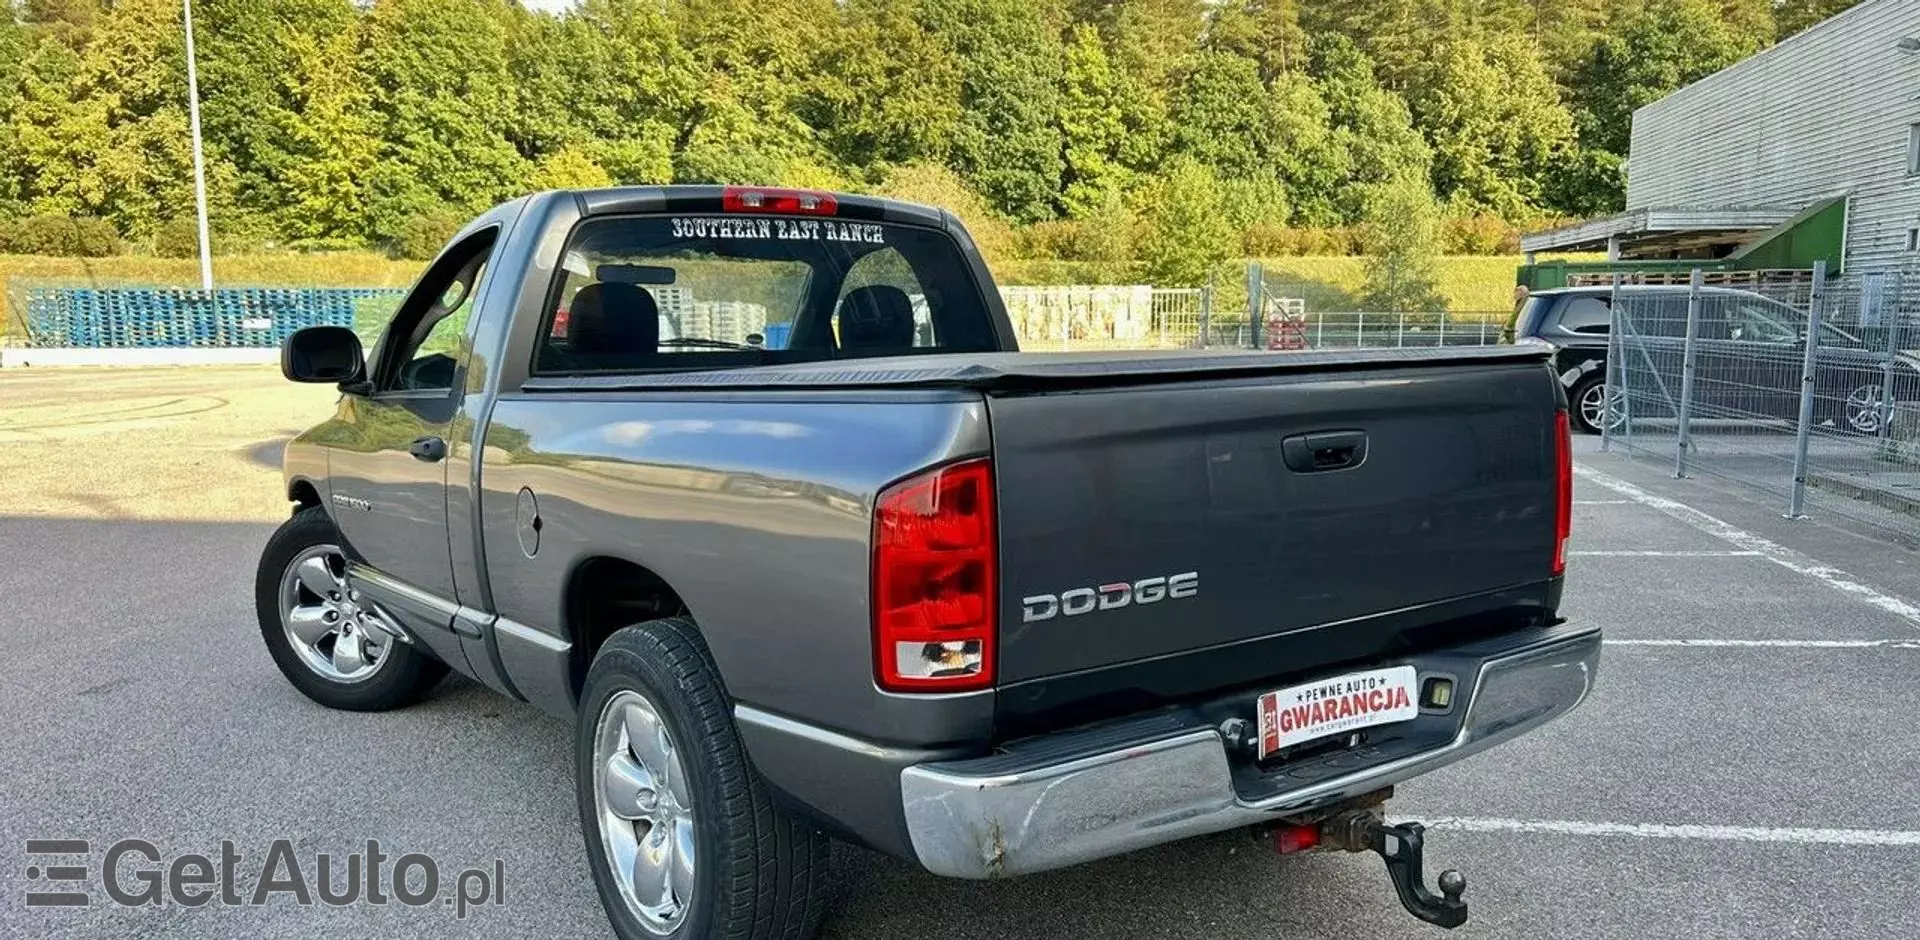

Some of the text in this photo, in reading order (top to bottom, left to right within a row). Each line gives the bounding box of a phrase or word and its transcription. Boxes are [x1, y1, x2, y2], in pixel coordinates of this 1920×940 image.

[671, 218, 885, 244] SOUTHERN EAST RANCH
[1022, 571, 1199, 623] DODGE
[1306, 677, 1376, 702] PEWNE AUTO
[1279, 686, 1410, 733] GWARANCJA
